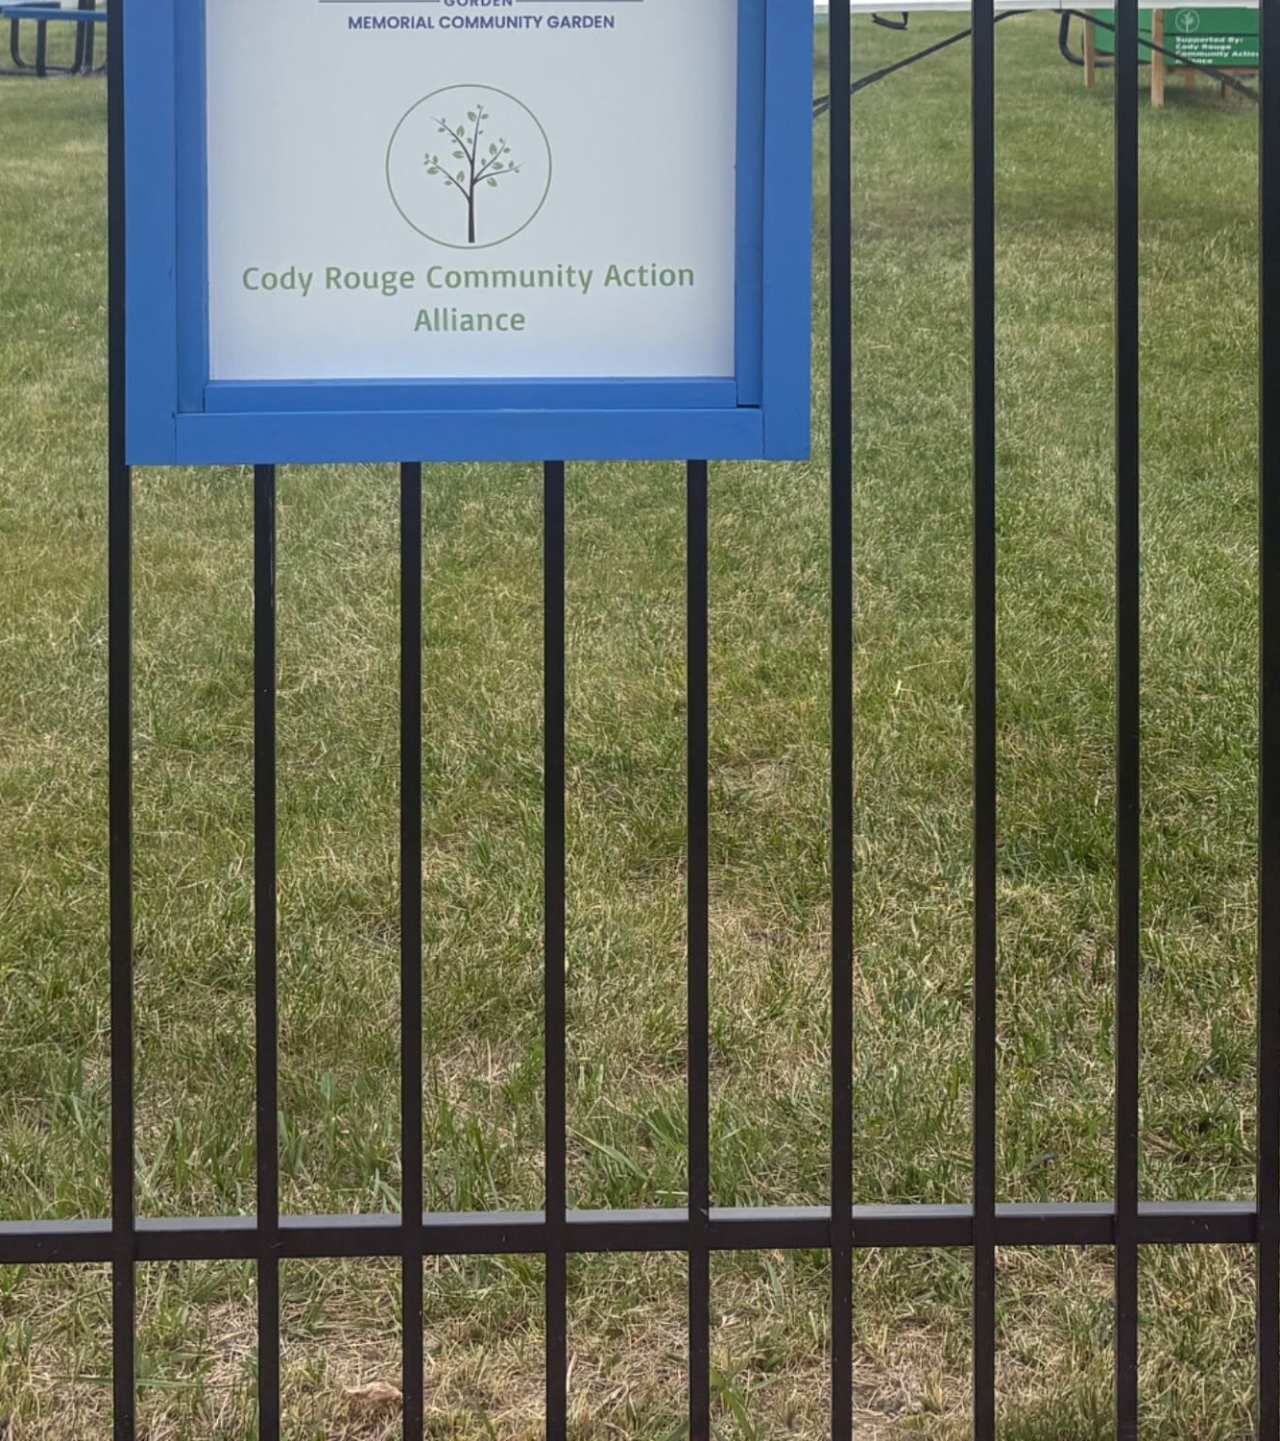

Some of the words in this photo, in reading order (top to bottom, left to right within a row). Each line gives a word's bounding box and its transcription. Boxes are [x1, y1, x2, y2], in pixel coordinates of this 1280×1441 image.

[348, 16, 435, 29] MEMORIAL
[438, 15, 543, 29] COMMUNITY
[546, 15, 615, 29] GARDEN
[242, 266, 313, 297] Cody
[326, 265, 415, 297] Rouge
[427, 263, 593, 295] Community
[604, 262, 694, 288] Action
[414, 307, 525, 332] Alliance
